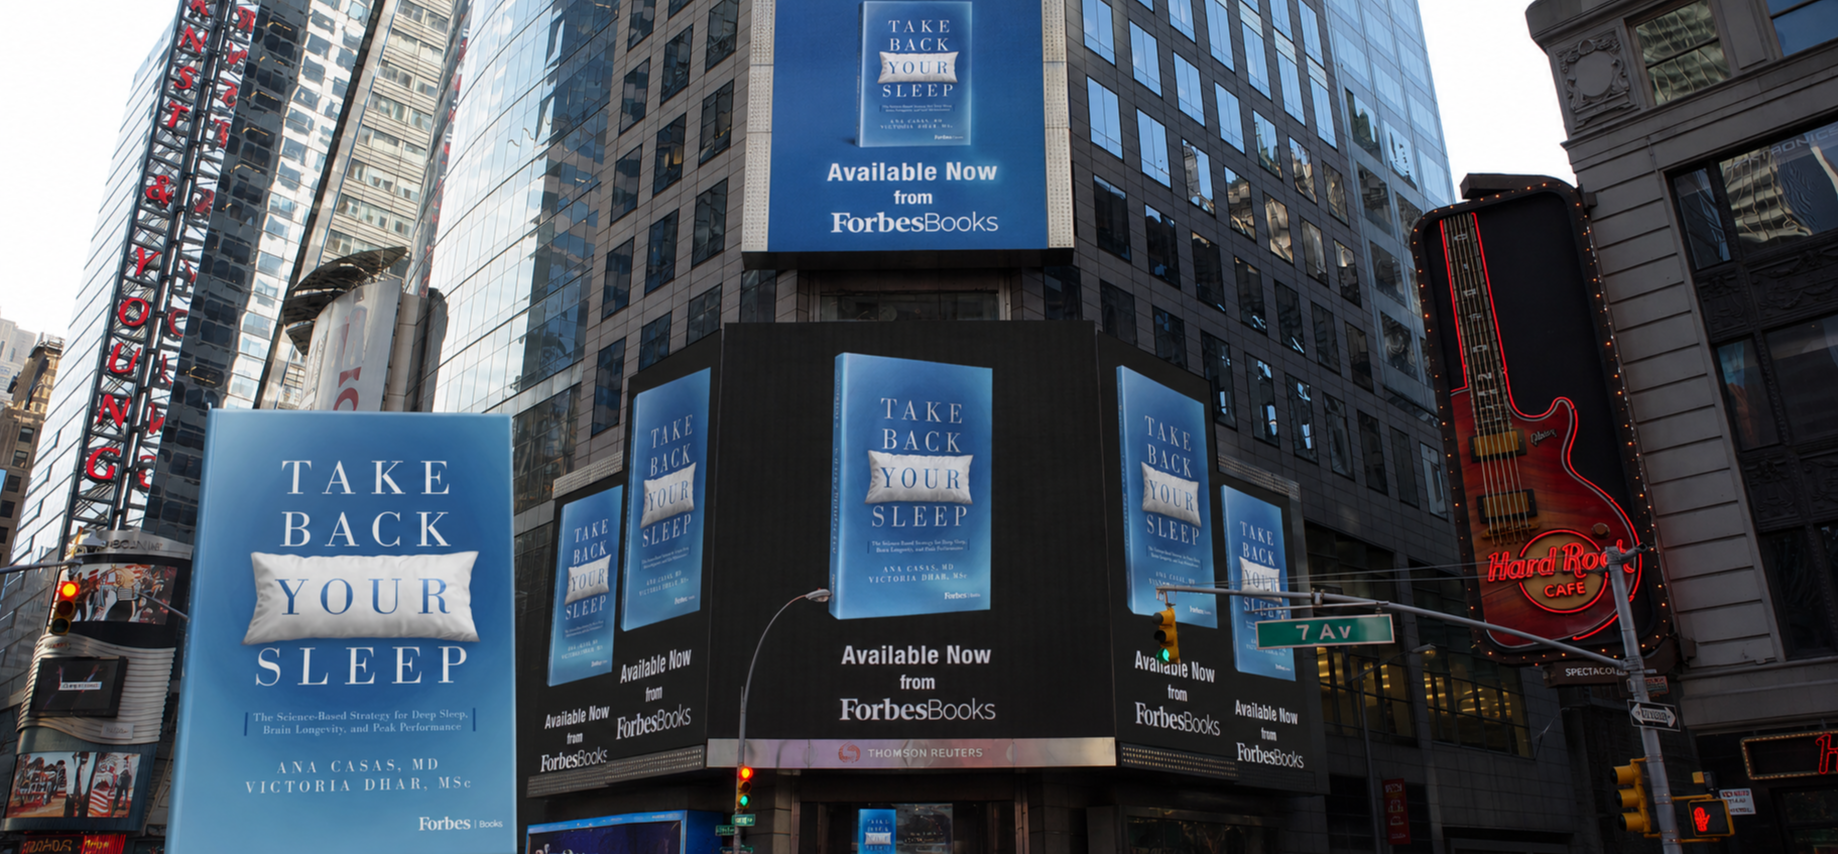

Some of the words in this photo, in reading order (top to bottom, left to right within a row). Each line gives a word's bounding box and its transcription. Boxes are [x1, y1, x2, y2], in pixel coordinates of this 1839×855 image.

[888, 19, 950, 33] TAKE
[889, 37, 949, 52] BACK
[888, 60, 948, 74] YOUR
[882, 83, 953, 98] SLEEP
[826, 162, 938, 182] Available
[945, 161, 998, 181] Now
[145, 175, 173, 209] &
[893, 189, 933, 205] from
[830, 211, 999, 233] ForbesBooks
[86, 247, 161, 480] YOUNG
[880, 397, 963, 424] TAKE
[650, 414, 693, 449] TAKE
[881, 428, 962, 453] BACK
[1144, 415, 1192, 452] TAKE
[649, 442, 691, 477] BACK
[1147, 443, 1192, 478] BACK
[281, 460, 450, 495] TAKE
[880, 467, 961, 489] YOUR
[648, 480, 689, 511] YOUR
[1149, 479, 1194, 512] YOUR
[279, 511, 451, 547] BACK
[871, 505, 967, 528] SLEEP
[574, 518, 609, 543] TAKE
[642, 513, 692, 548] SLEEP
[1146, 514, 1200, 546] SLEEP
[1239, 520, 1274, 547] TAKE
[573, 540, 607, 565] BACK
[1242, 541, 1275, 567] BACK
[1487, 546, 1557, 582] Hard
[571, 568, 605, 592] YOUR
[1543, 581, 1586, 598] CAFE
[274, 578, 451, 615] YOUR
[565, 594, 607, 620] SLEEP
[1295, 624, 1310, 641] 7
[1319, 623, 1351, 640] Av
[255, 645, 467, 687] SLEEP
[620, 654, 666, 684] Available
[668, 649, 692, 671] Now
[841, 645, 939, 665] Available
[946, 645, 992, 665] Now
[899, 674, 936, 690] from
[1191, 661, 1215, 683] Now
[645, 686, 663, 702] from
[1167, 684, 1188, 702] from
[253, 712, 273, 722] The
[276, 711, 347, 722] Science-Based
[350, 710, 391, 722] Strategy
[394, 709, 409, 720] for
[412, 709, 437, 721] Deep
[544, 708, 587, 730] Available
[588, 705, 610, 722] Now
[839, 697, 997, 721] ForbesBooks
[1134, 701, 1221, 737] ForbesBooks
[1235, 699, 1277, 722] Available
[1278, 707, 1299, 725] Now
[263, 725, 292, 735] Brain
[350, 723, 369, 733] and
[372, 722, 397, 733] Peak
[399, 722, 462, 733] Performance
[615, 704, 692, 740] ForbesBooks
[1260, 727, 1277, 741] from
[566, 732, 583, 745] from
[276, 760, 317, 774] ANA
[330, 758, 402, 773] CASAS,
[412, 757, 439, 771] MD
[868, 748, 927, 759] THOMSON
[931, 748, 983, 758] REUTERS
[1236, 742, 1304, 769] ForbesBooks
[245, 779, 351, 794] VICTORIA
[364, 777, 428, 792] DHAR,
[438, 775, 472, 789] MSc
[418, 816, 471, 831] Forbes
[479, 819, 503, 828] Books
